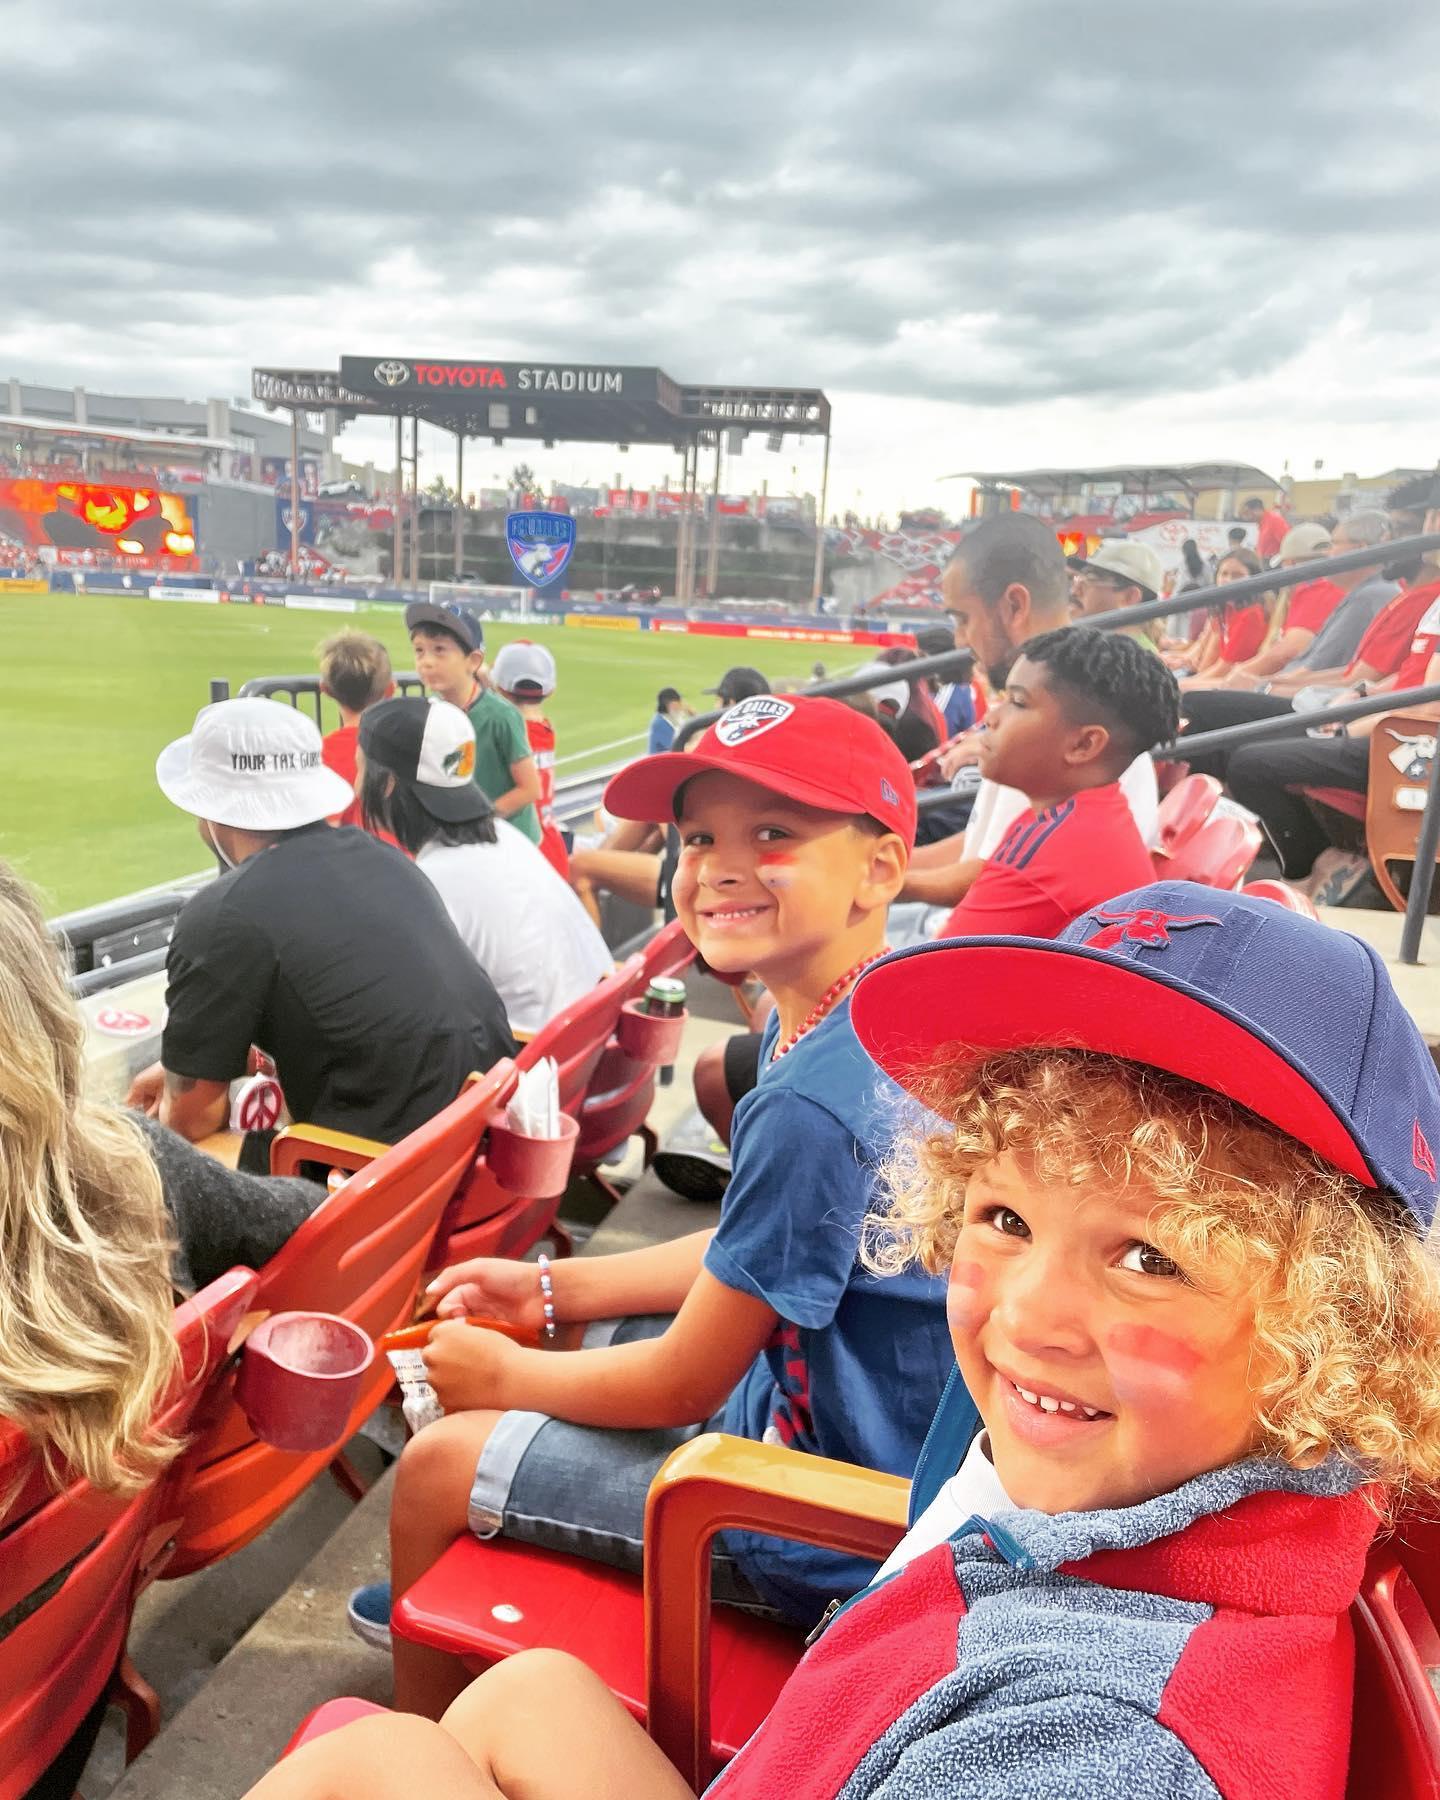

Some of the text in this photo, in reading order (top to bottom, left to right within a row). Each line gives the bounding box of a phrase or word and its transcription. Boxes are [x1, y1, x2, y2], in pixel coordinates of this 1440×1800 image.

[415, 365, 623, 393] TOYOTA STADIUM
[231, 753, 266, 770] YOUR
[272, 752, 296, 769] TAX
